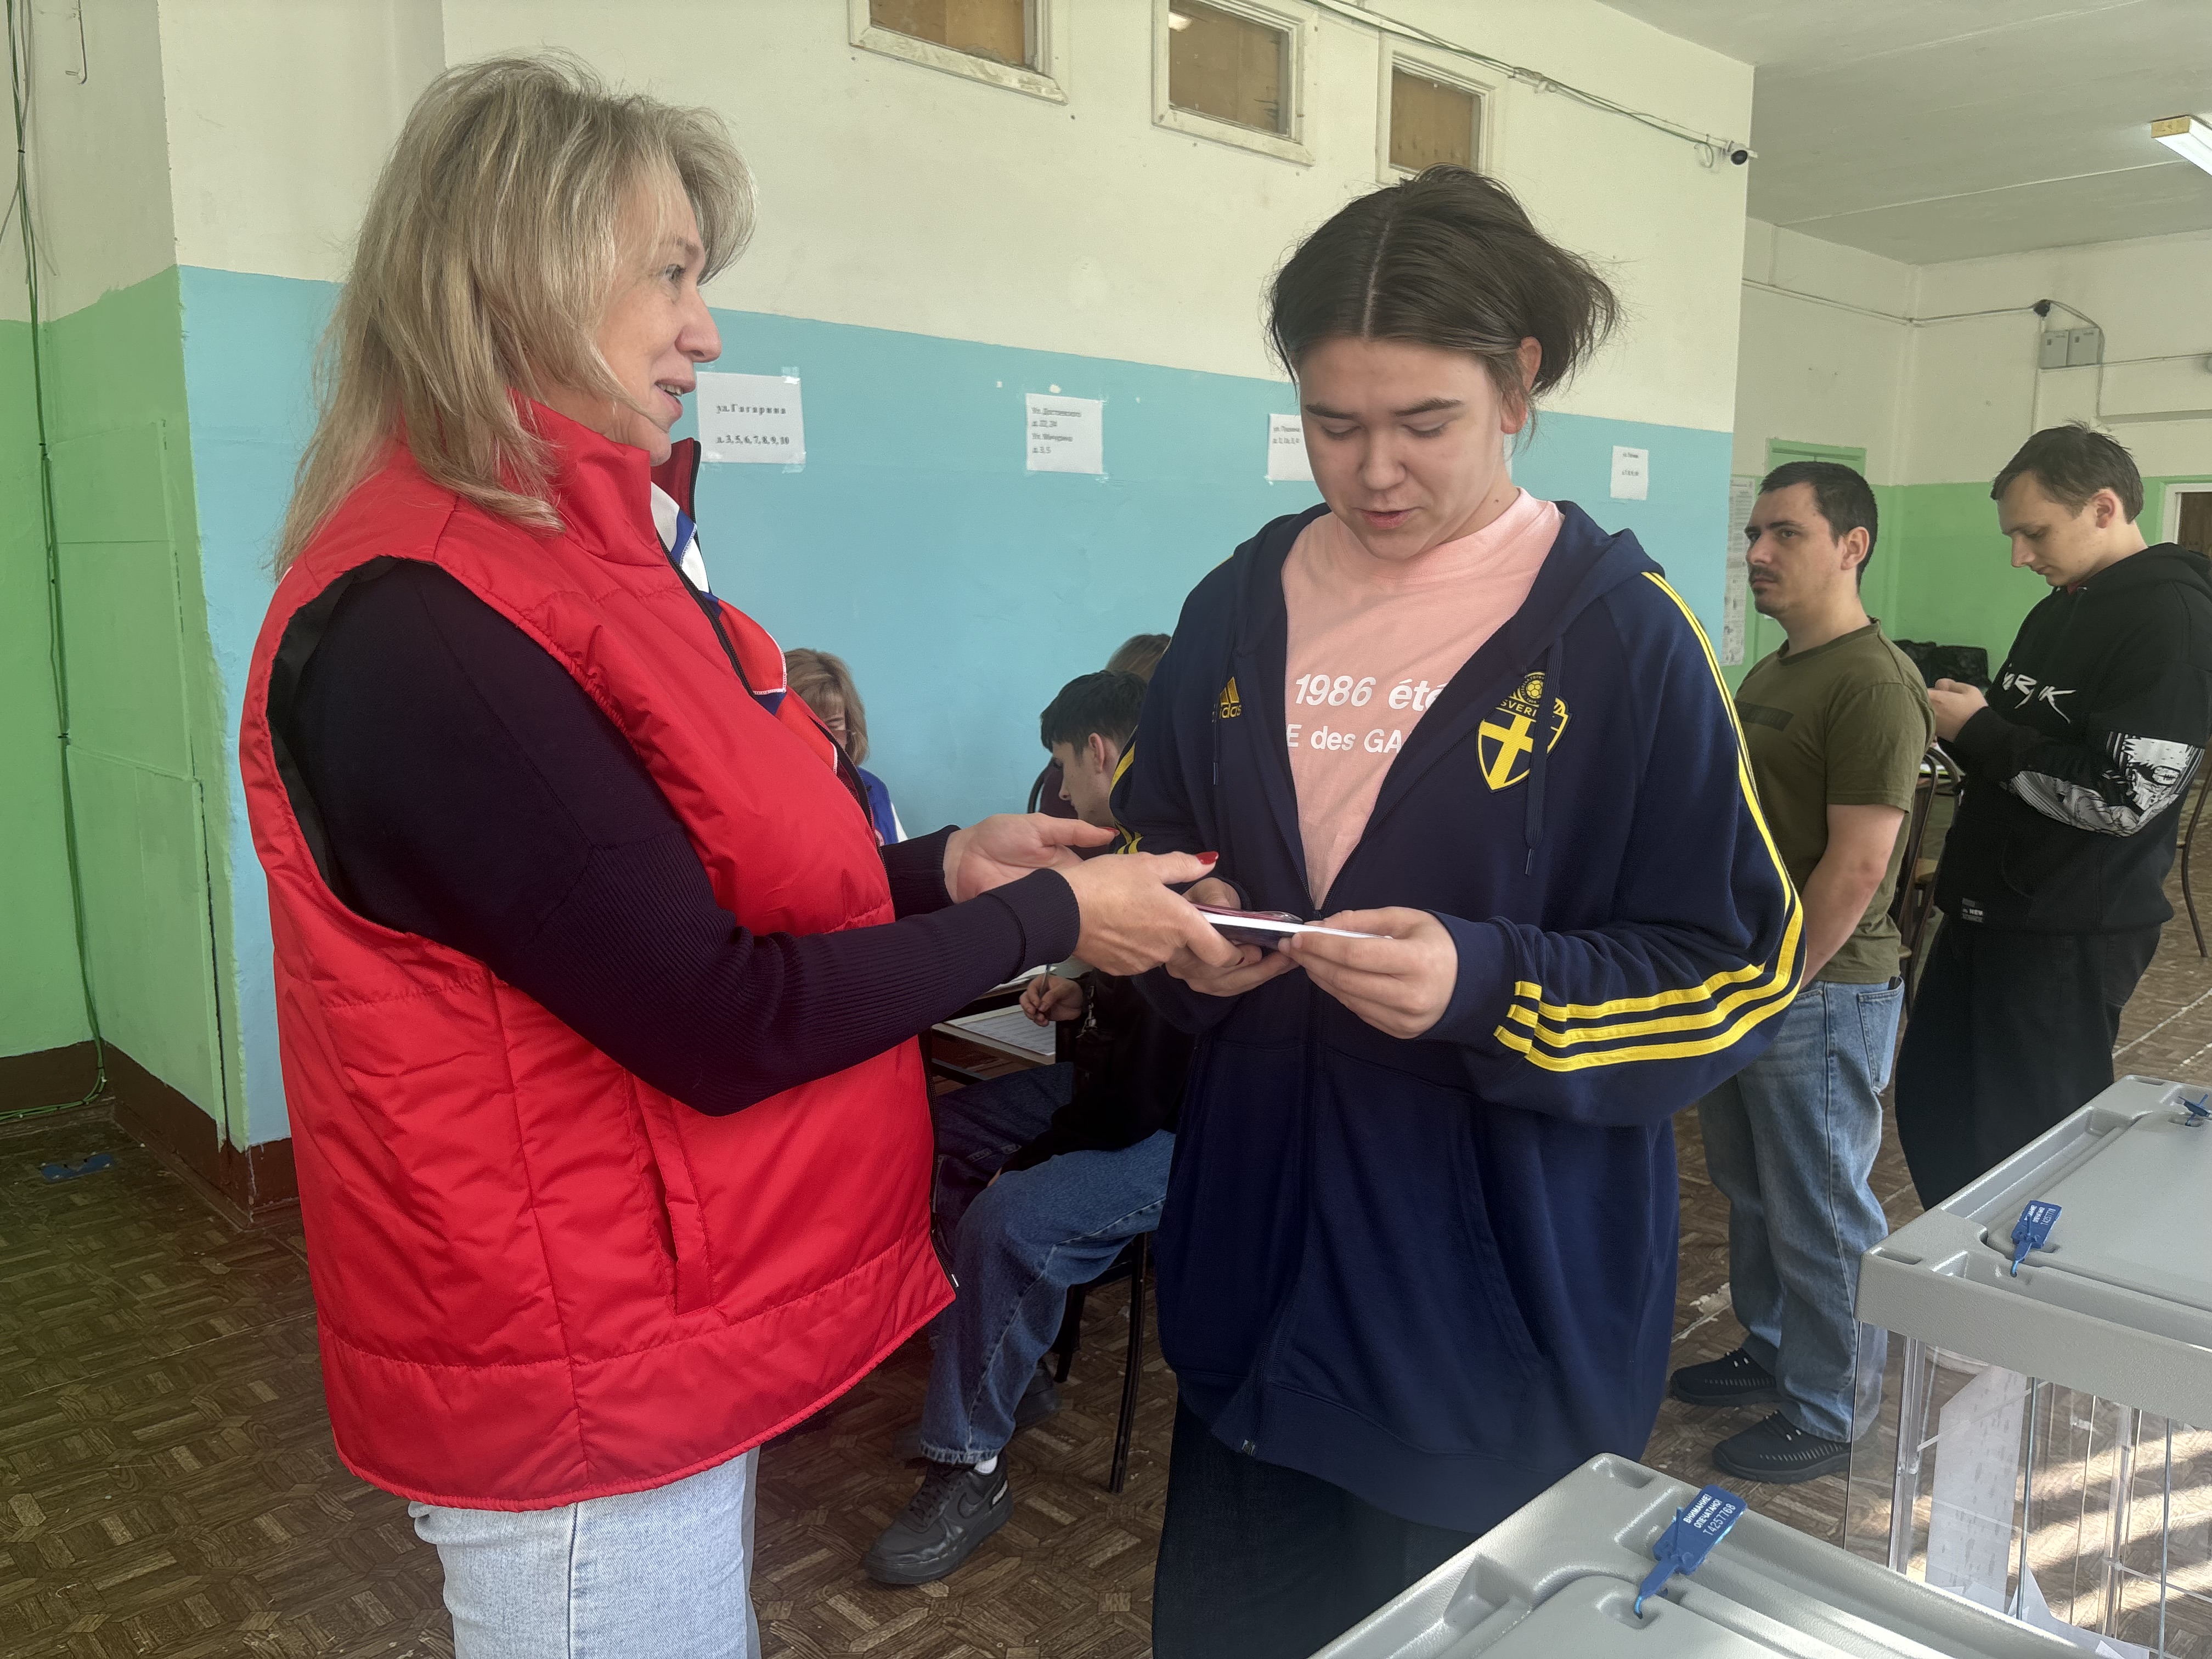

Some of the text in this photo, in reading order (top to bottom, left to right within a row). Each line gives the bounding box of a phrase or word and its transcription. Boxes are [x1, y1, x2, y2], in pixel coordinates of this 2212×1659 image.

[1295, 674, 1376, 707] 1986
[1499, 699, 1539, 718] SVERI
[1310, 725, 1357, 751] des
[1363, 728, 1403, 754] GA
[1683, 1493, 1712, 1524] ВНИМАНИЕ!
[1694, 1498, 1723, 1528] ОПЕЧАТАНО!
